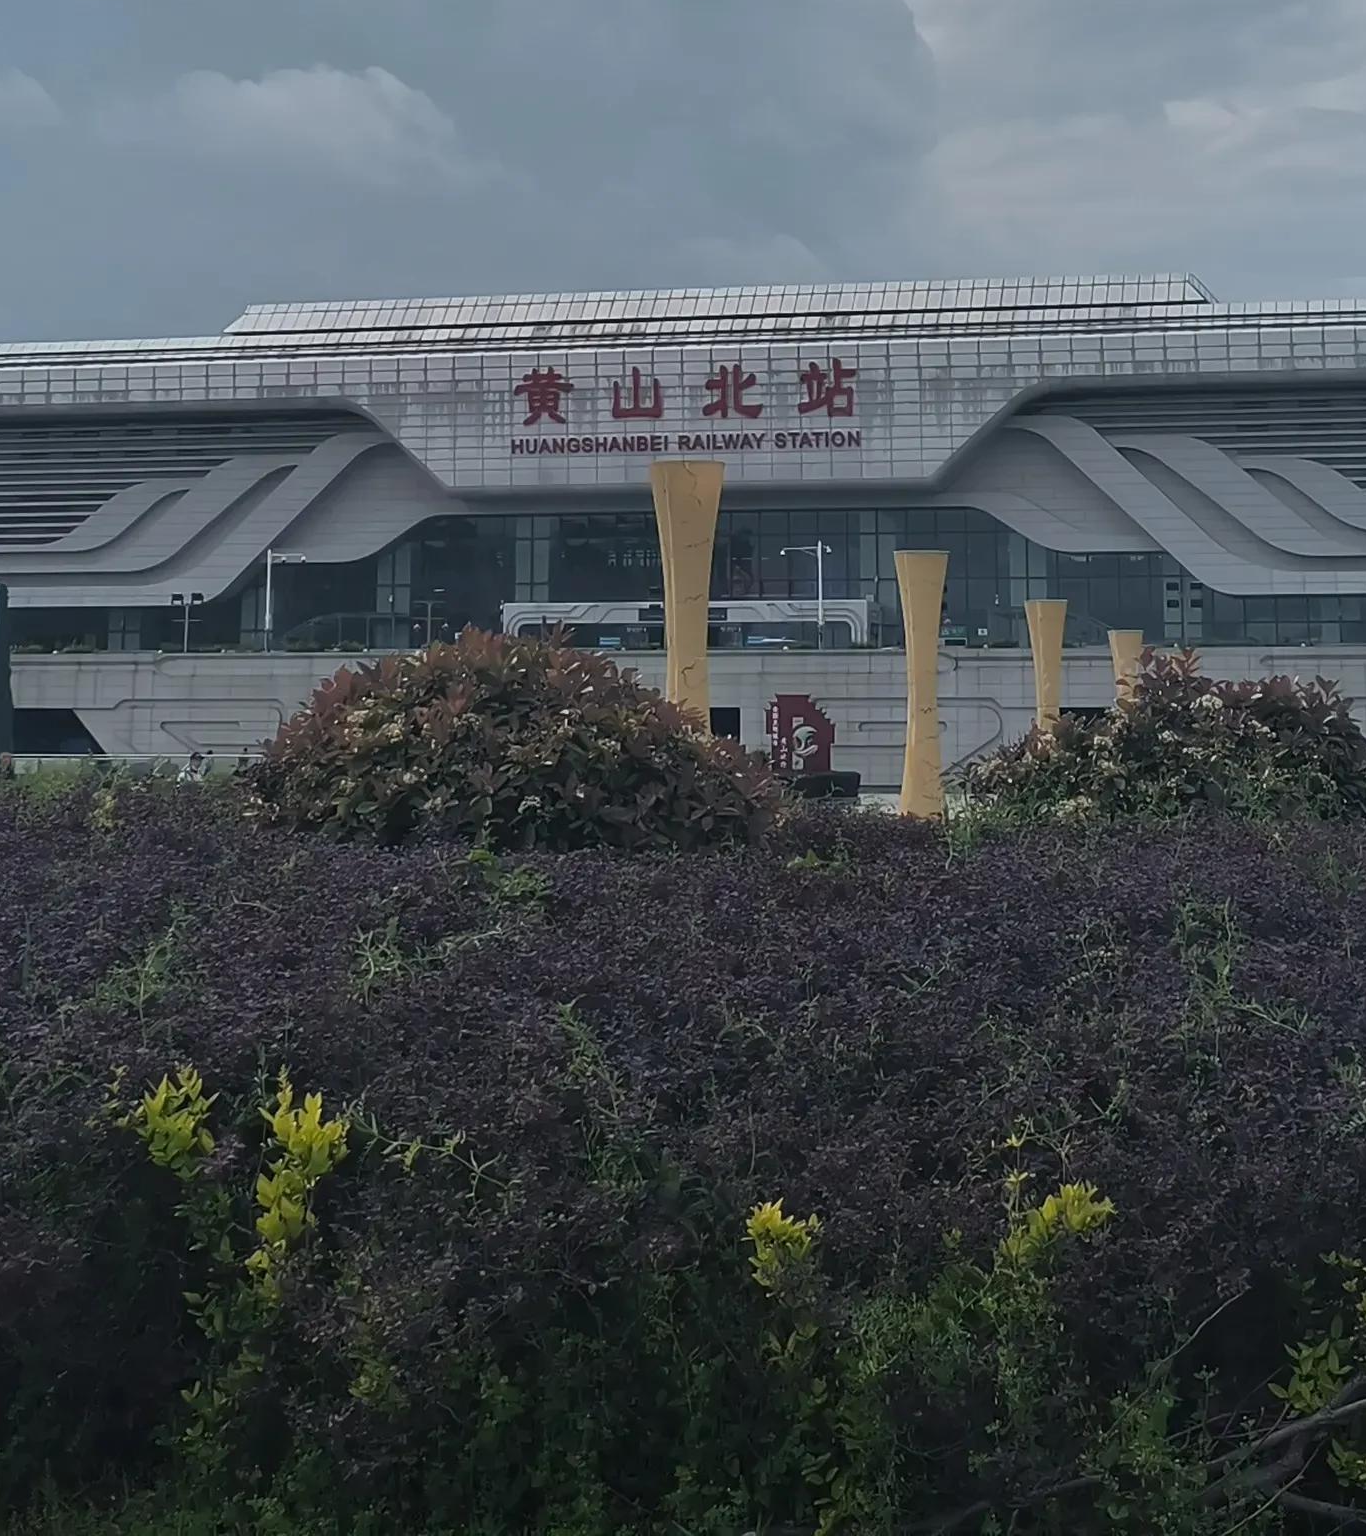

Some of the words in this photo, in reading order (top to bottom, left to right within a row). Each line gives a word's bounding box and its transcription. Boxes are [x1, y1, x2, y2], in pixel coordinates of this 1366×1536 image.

[514, 358, 856, 425] 黄山北站
[511, 435, 669, 455] HUANGSHANBEI
[678, 432, 767, 452] RAILWAY
[774, 430, 861, 449] STATION
